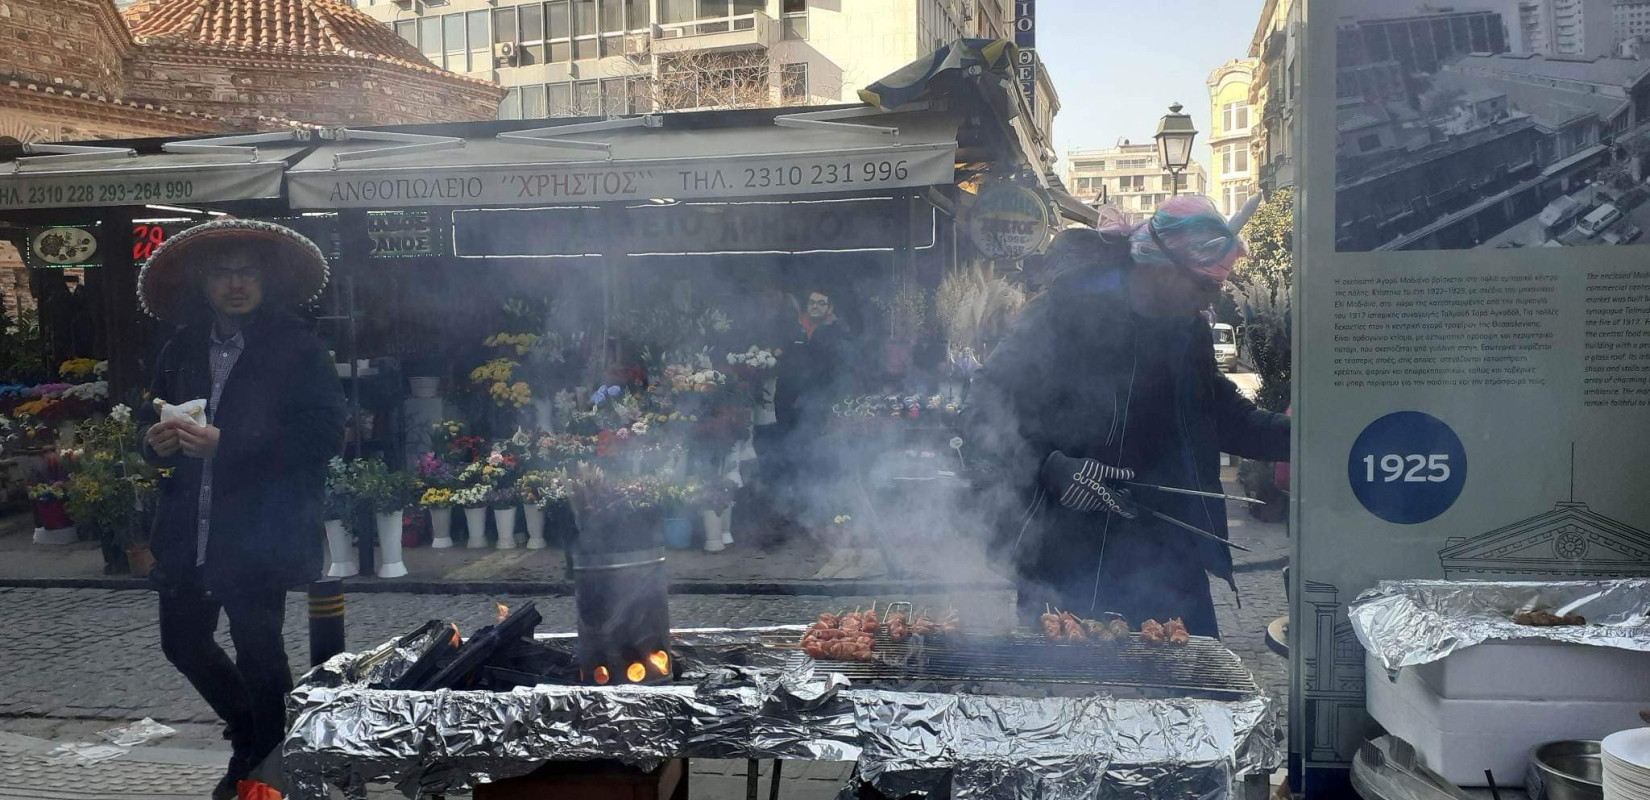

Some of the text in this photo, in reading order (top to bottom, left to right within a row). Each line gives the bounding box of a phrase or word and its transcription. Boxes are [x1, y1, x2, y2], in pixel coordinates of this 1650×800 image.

[29, 186, 62, 204] 2310
[68, 185, 94, 202] 228
[100, 182, 161, 201] 293-264
[166, 180, 192, 198] 990
[330, 176, 482, 201] ΑΝΘΟΠΩΛΕΙΟ
[679, 170, 733, 191] ΤΗΛ.
[744, 166, 802, 188] 2310
[811, 163, 853, 185] 231
[863, 160, 908, 182] 996
[1364, 454, 1450, 482] 1925
[1073, 472, 1136, 518] OUTDOORC
